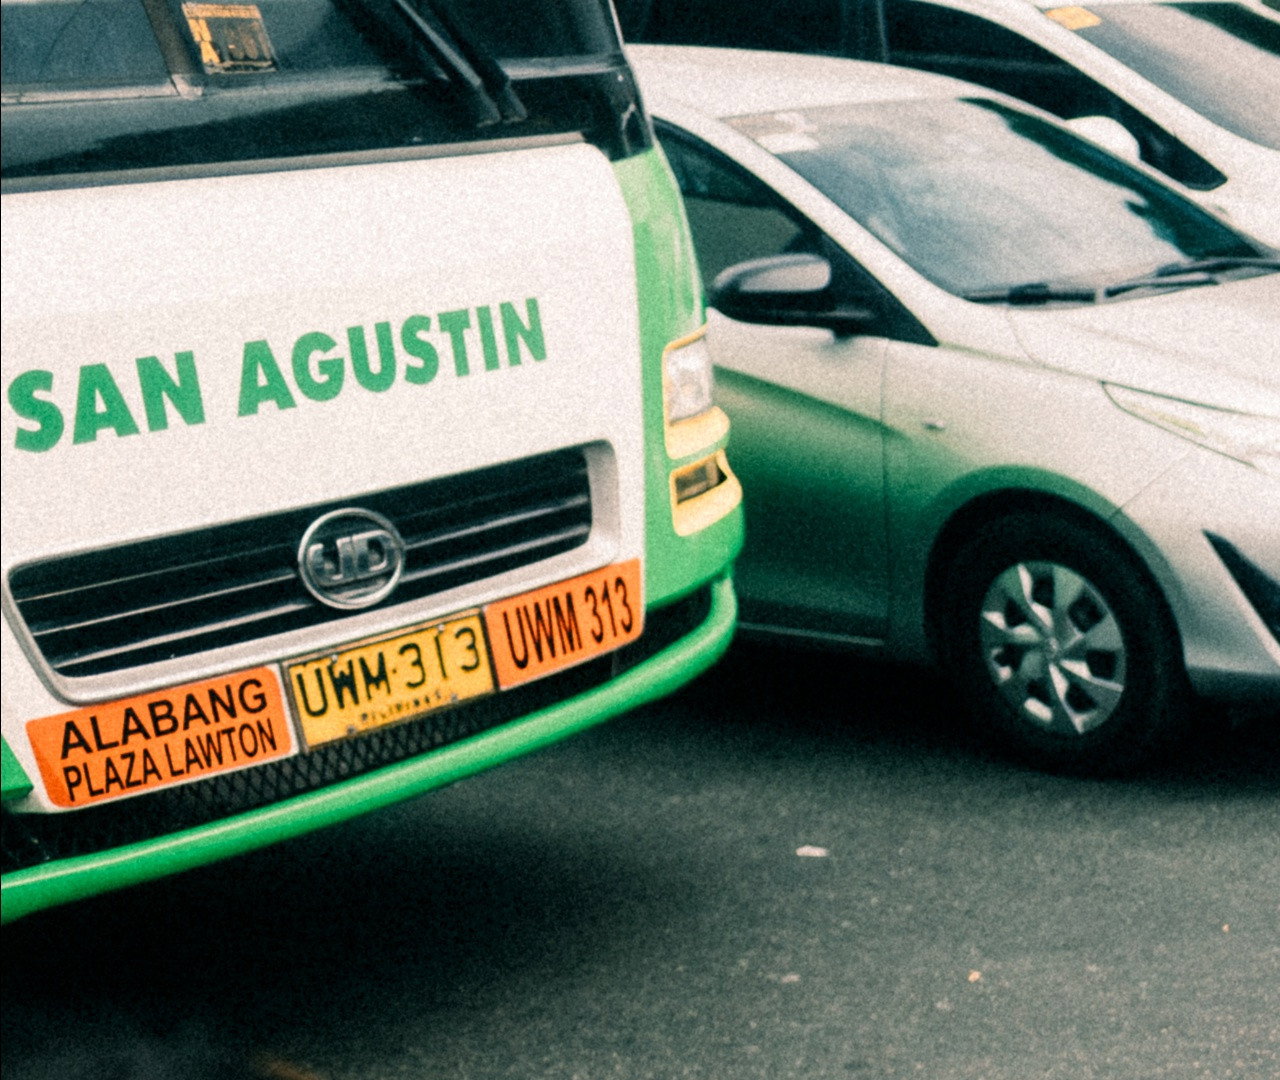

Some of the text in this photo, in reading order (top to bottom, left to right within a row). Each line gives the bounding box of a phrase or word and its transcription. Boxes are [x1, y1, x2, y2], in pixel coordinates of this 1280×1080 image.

[8, 297, 547, 453] SAN AGUSTIN
[308, 530, 390, 587] UD
[503, 576, 635, 670] UWM 313
[60, 679, 268, 760] ALABANG
[63, 718, 277, 802] PLAZA LAWTON
